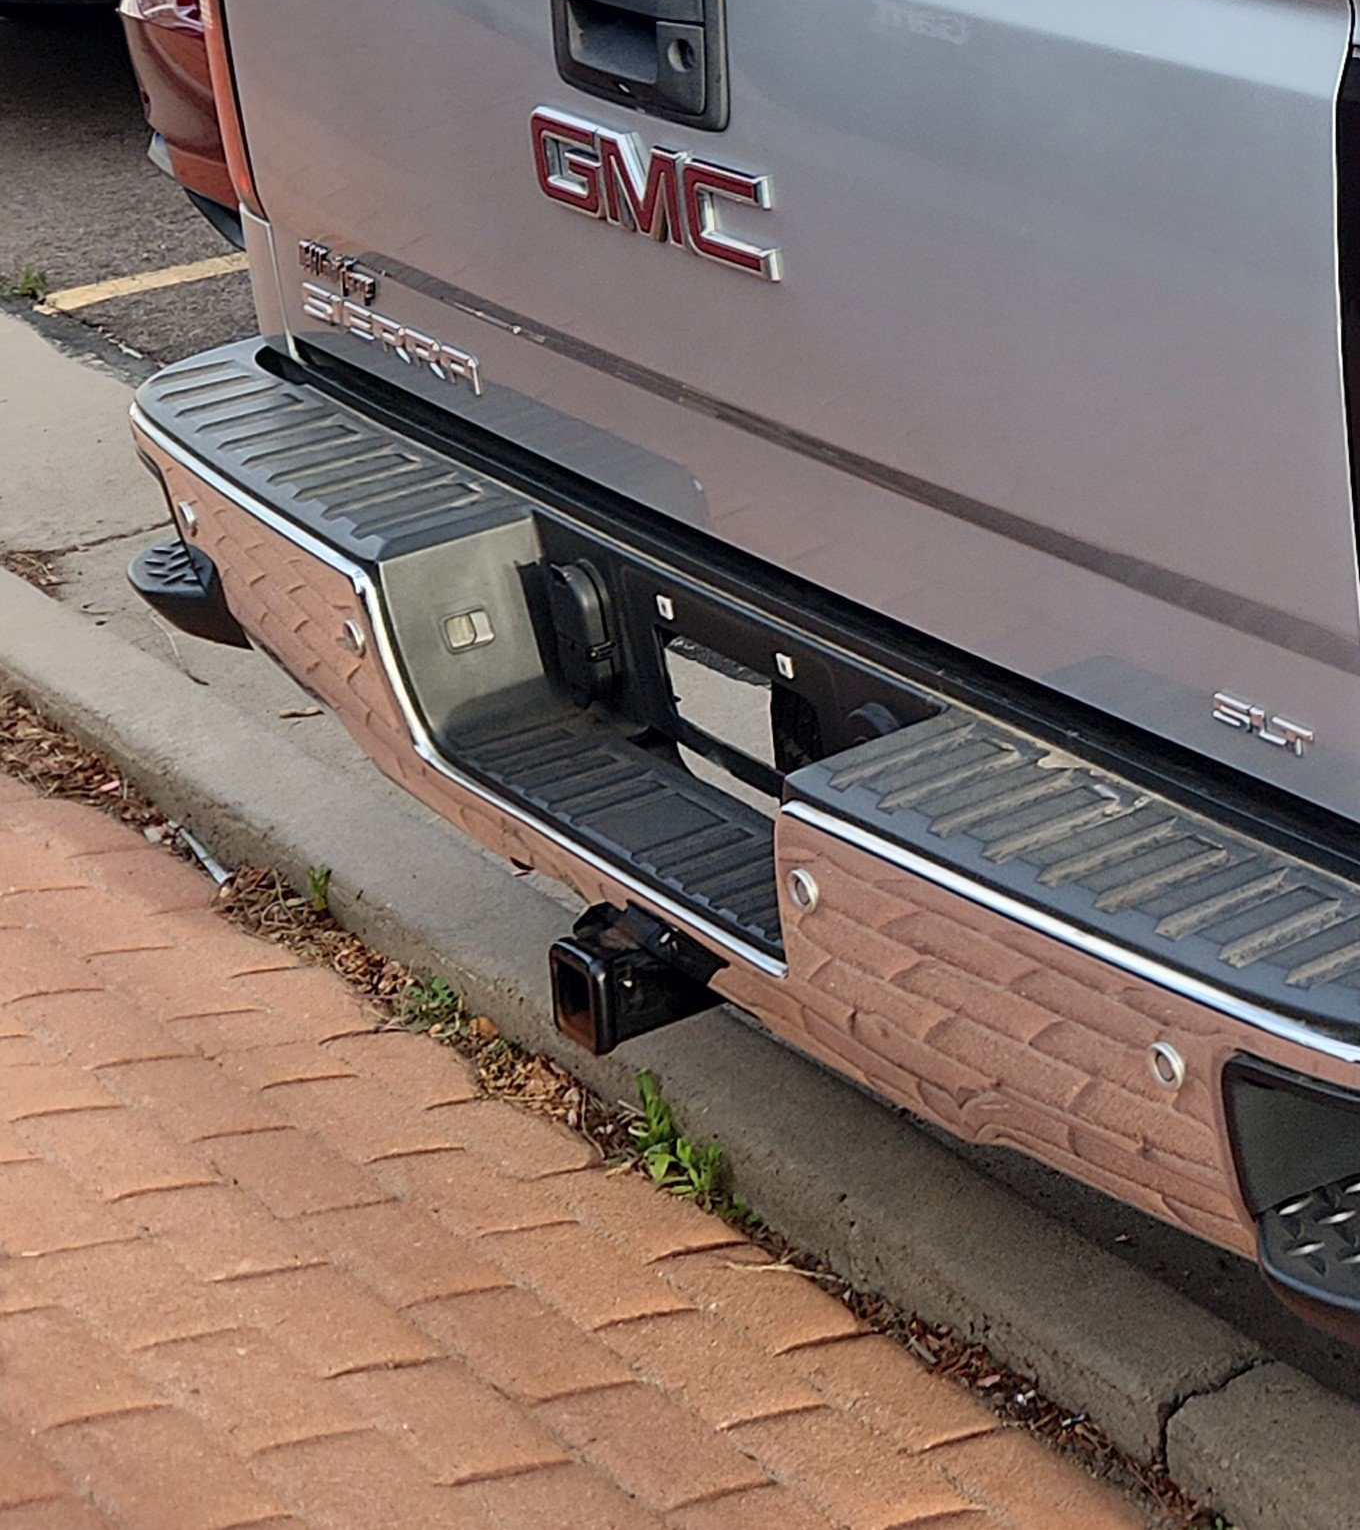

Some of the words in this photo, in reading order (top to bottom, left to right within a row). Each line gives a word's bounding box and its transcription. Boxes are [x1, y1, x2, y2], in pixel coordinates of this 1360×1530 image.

[529, 105, 783, 283] GMC
[302, 280, 481, 396] SIERRA
[1212, 692, 1315, 757] SLT
